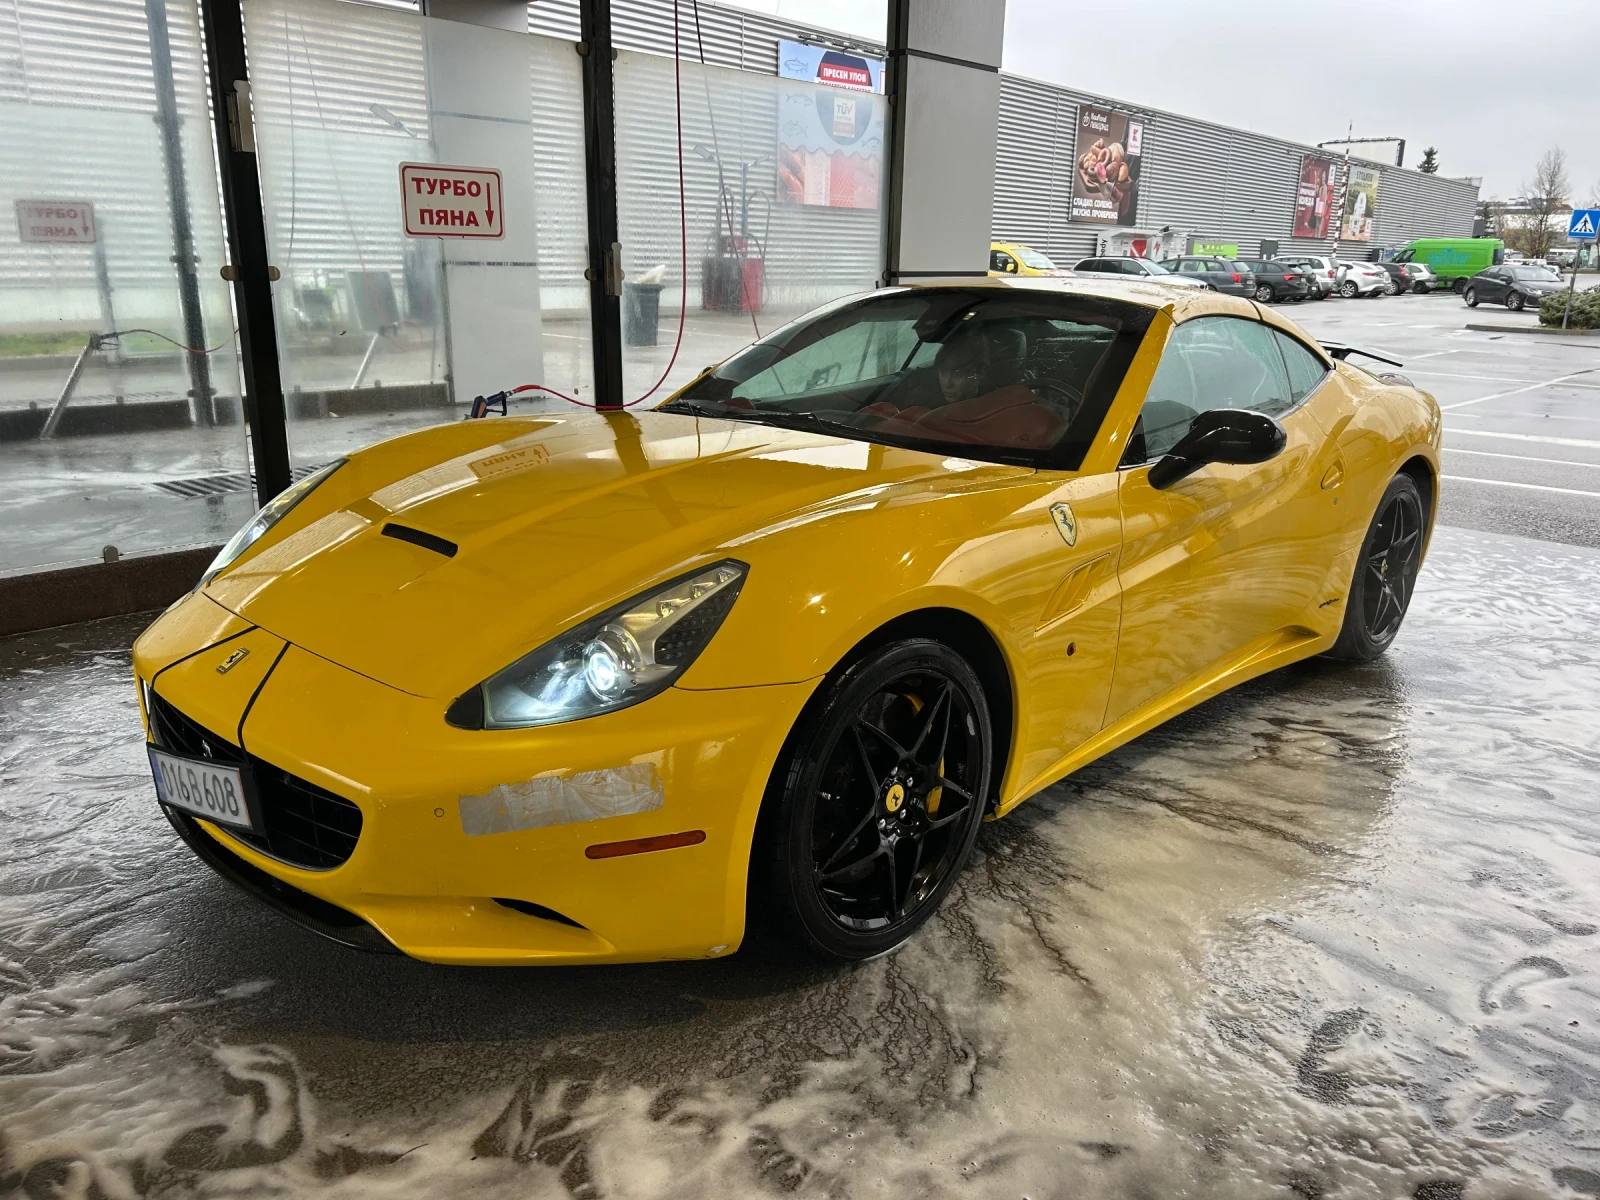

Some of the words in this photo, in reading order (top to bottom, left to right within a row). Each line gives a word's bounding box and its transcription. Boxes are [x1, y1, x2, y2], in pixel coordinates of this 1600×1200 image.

[823, 68, 848, 80] ПРЕСЕН
[849, 72, 867, 83] УЛОВ
[411, 177, 481, 197] ТУРБО
[419, 208, 480, 227] ПЯНА
